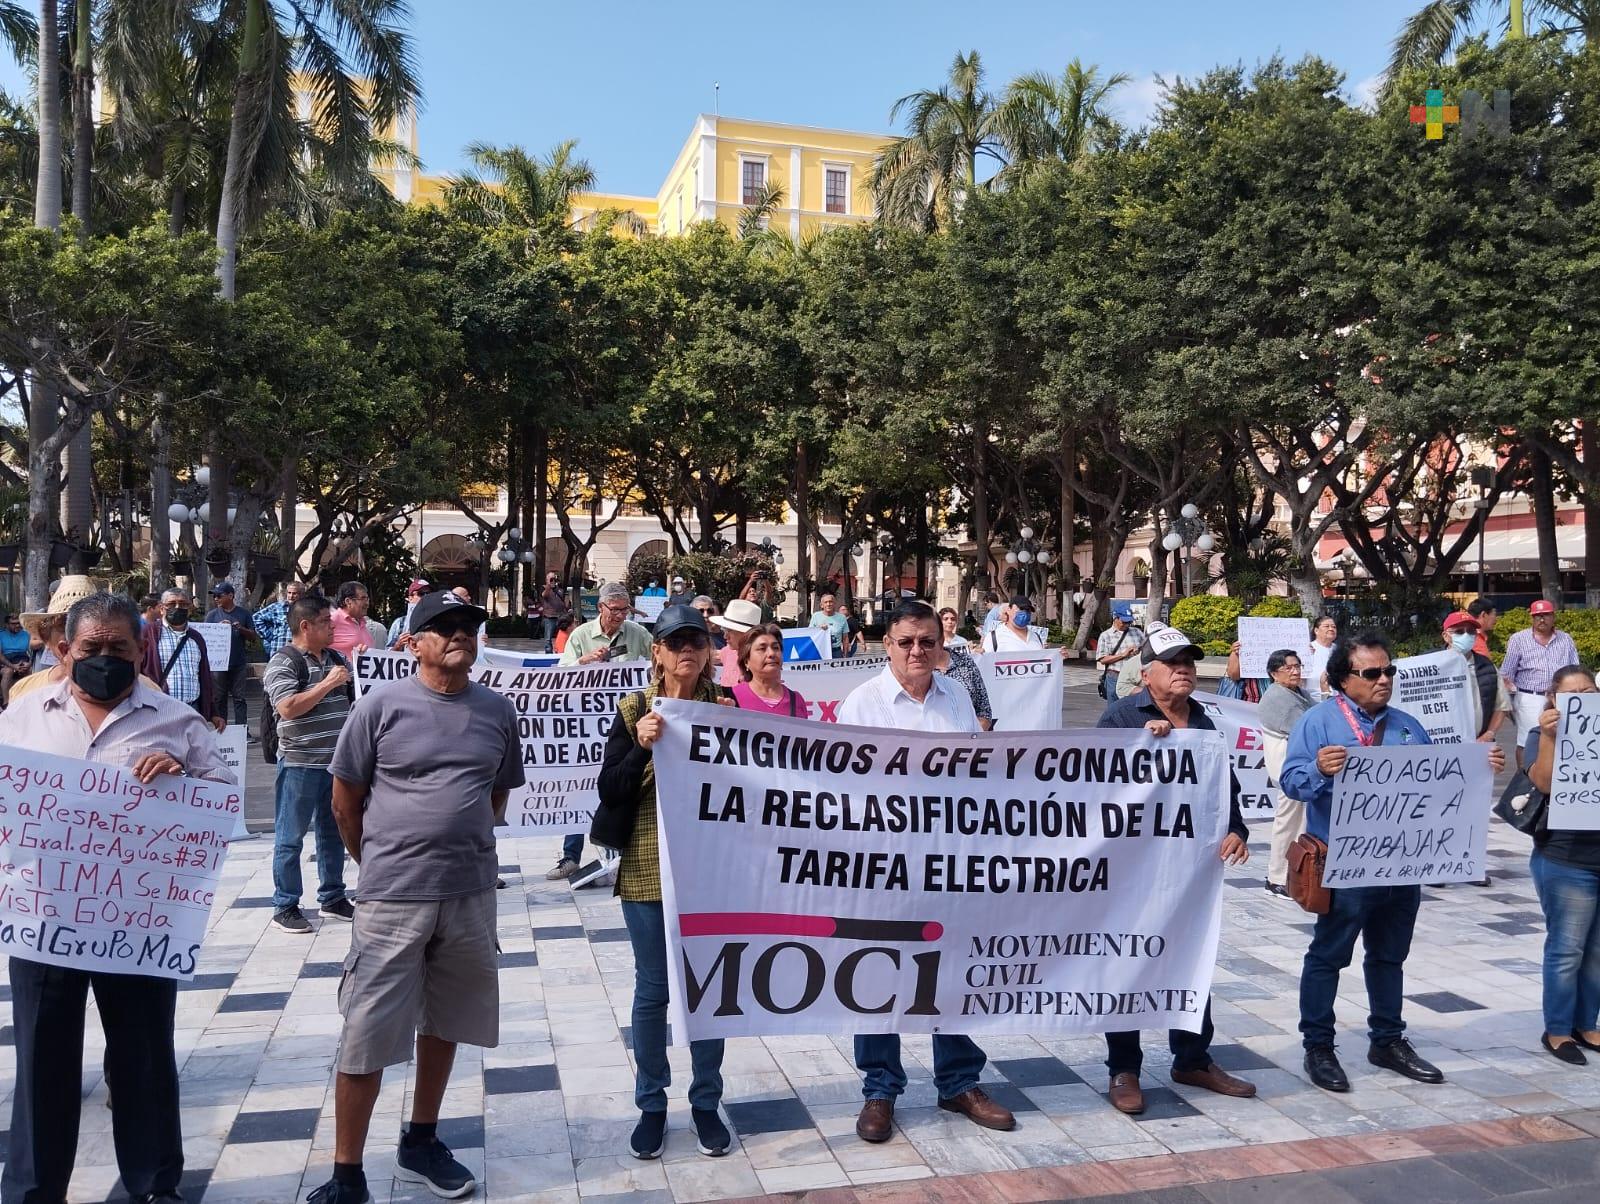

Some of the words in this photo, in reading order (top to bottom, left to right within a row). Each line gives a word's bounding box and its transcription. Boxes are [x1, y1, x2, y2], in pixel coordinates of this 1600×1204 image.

[478, 670, 502, 687] AL
[1398, 669, 1409, 680] SI
[1410, 664, 1440, 679] TIENES:
[537, 693, 573, 713] DEL
[1422, 704, 1433, 714] DE
[1434, 702, 1449, 713] CFE
[553, 718, 590, 738] DEL
[544, 743, 569, 764] DE
[689, 724, 877, 775] EXIGIMOS
[885, 747, 909, 776] A
[922, 747, 993, 779] CFE
[1006, 748, 1027, 780] Y
[1034, 747, 1198, 784] CONAGUA
[18, 802, 34, 817] a
[523, 795, 568, 809] CIVIL
[699, 783, 745, 823] LA
[762, 788, 1086, 838] RECLASIFICACIÓN
[1101, 803, 1144, 839] DE
[1153, 803, 1194, 839] LA
[1441, 788, 1464, 817] A
[778, 847, 908, 891] TARIFA
[924, 855, 1108, 894] ELECTRICA
[1326, 868, 1366, 883] FUERA
[1375, 867, 1392, 878] EL
[1438, 860, 1475, 876] MAS
[167, 875, 213, 906] hace
[968, 933, 1165, 959] MOVIMIENTO
[966, 963, 1043, 988] CIVIL
[960, 989, 1197, 1016] INDEPENDIENTE
